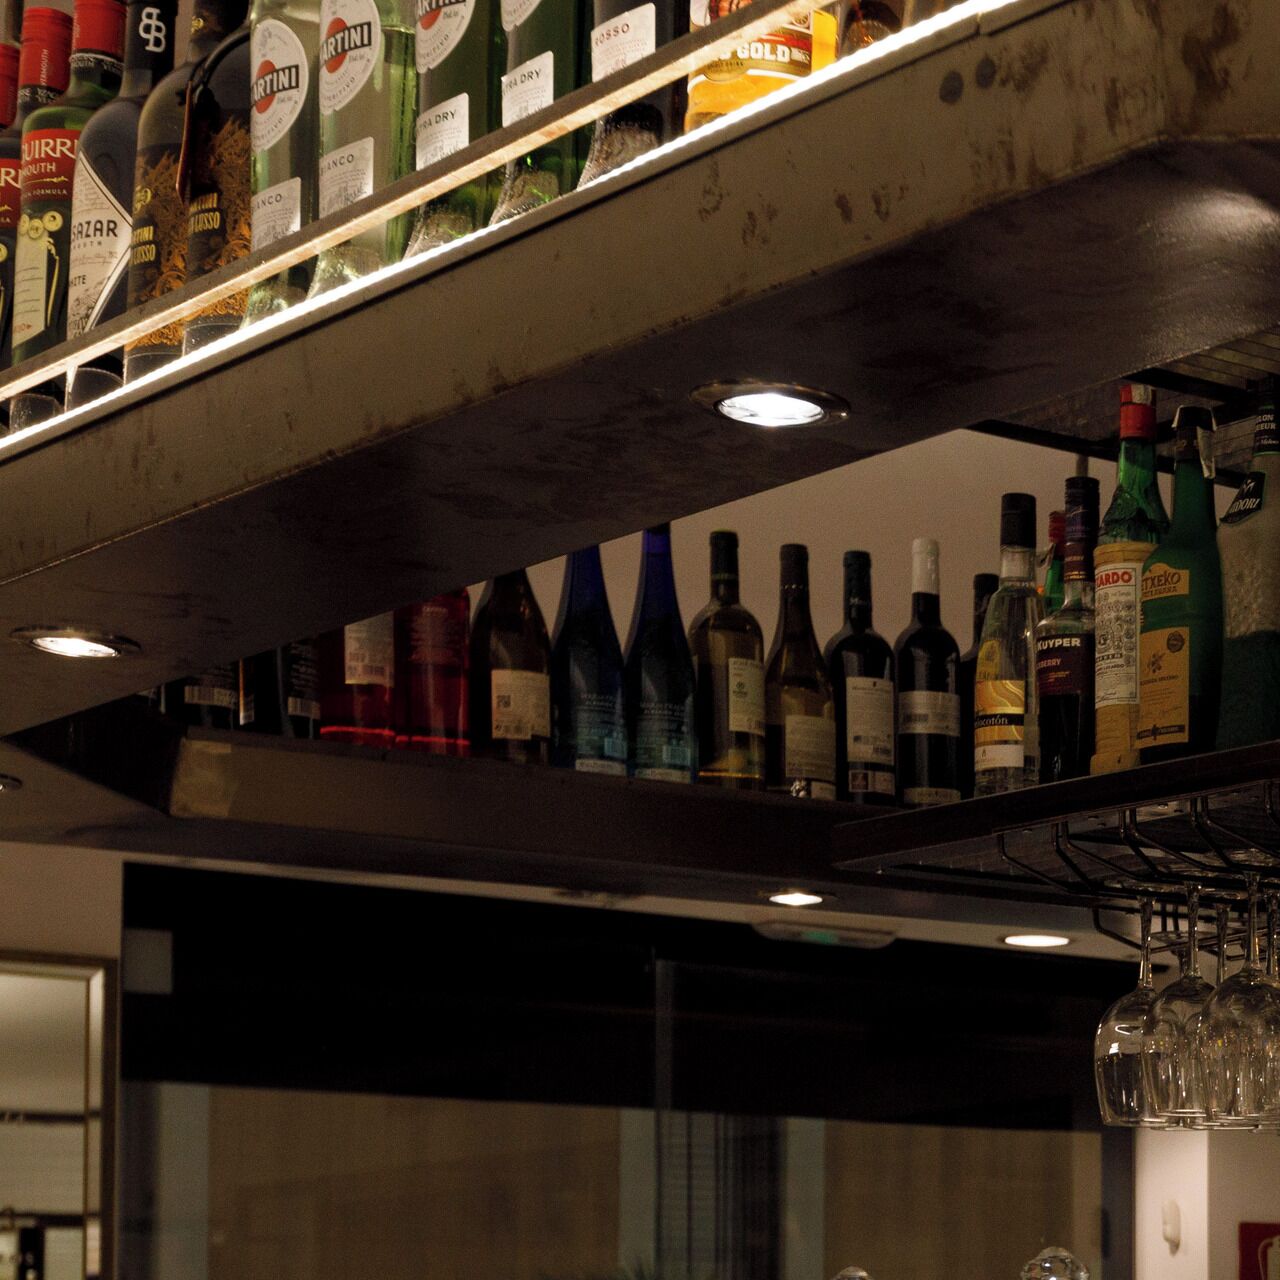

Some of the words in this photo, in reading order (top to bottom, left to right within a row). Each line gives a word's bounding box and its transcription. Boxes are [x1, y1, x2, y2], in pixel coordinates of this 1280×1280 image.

[737, 42, 790, 63] GOLD
[520, 69, 541, 84] DRY
[435, 108, 456, 124] DRY
[1037, 637, 1081, 651] KUYPER
